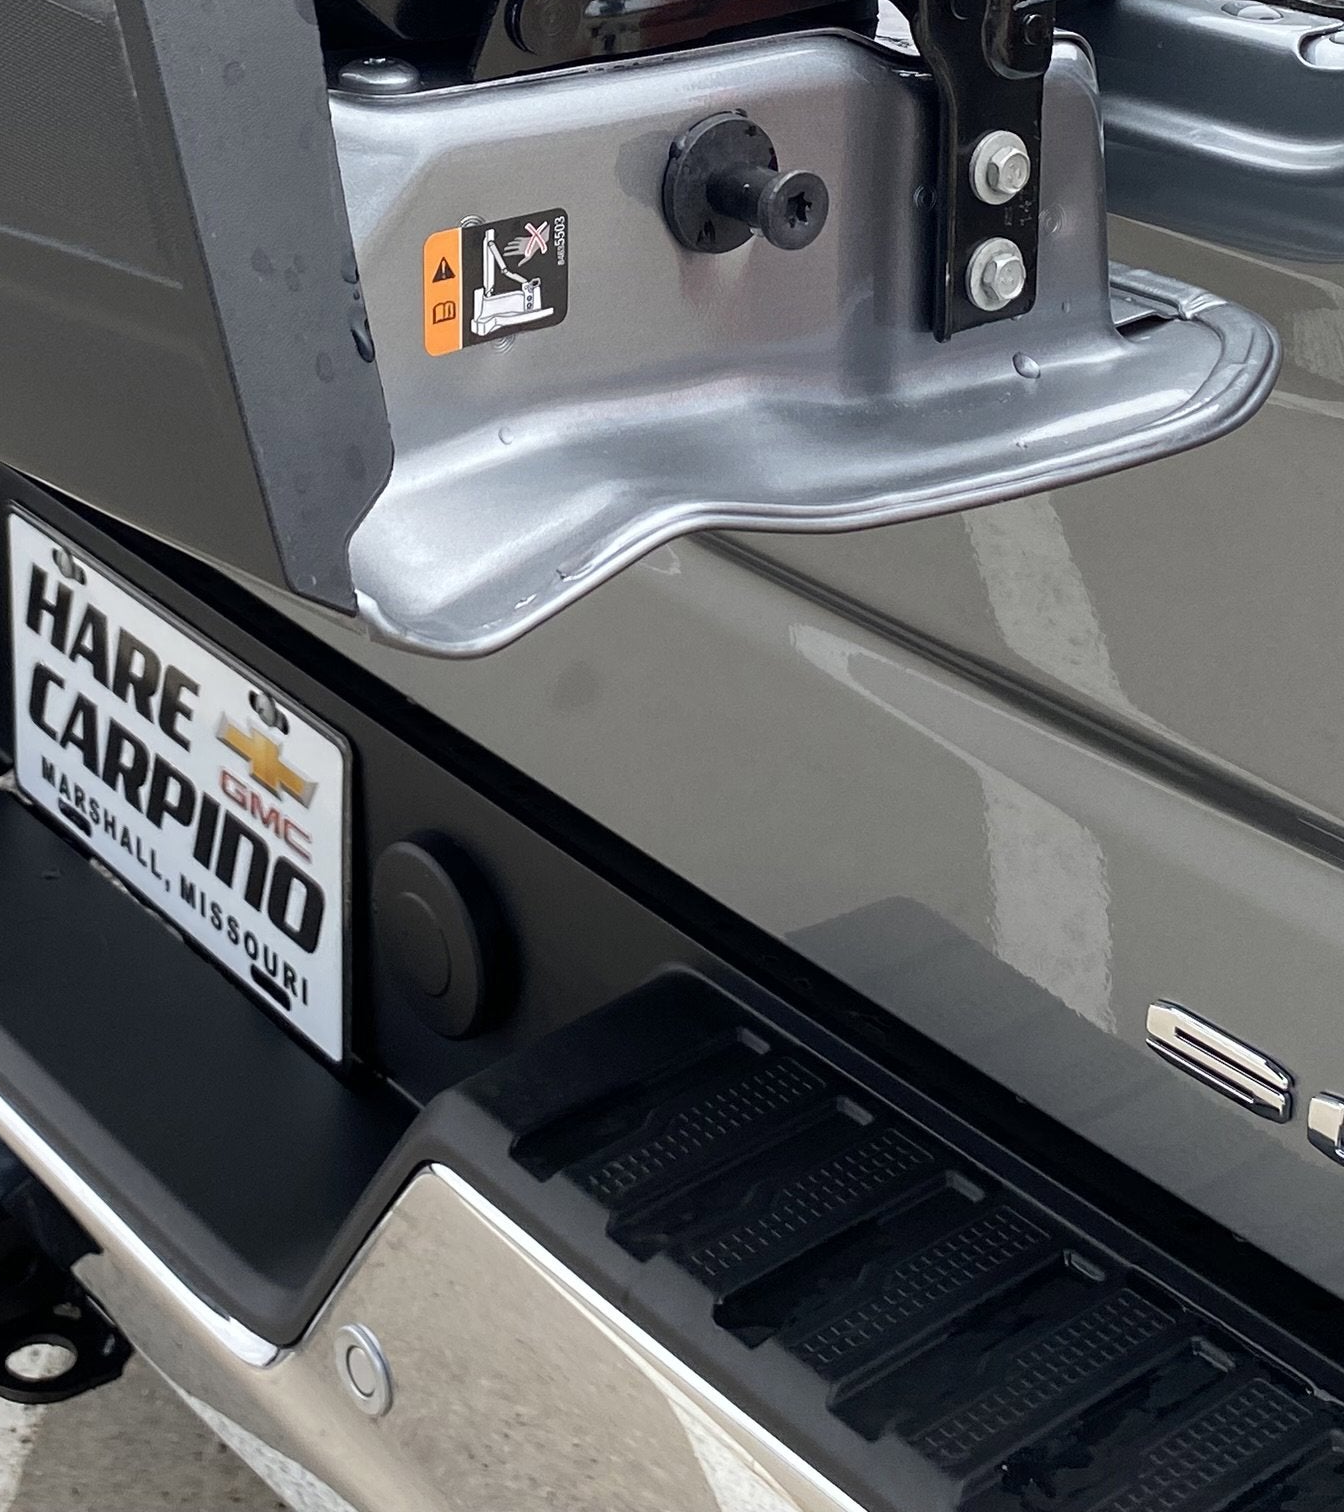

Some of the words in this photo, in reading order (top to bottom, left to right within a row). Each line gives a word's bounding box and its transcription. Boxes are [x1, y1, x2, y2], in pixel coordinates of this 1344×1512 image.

[26, 562, 200, 751] HARE
[28, 662, 326, 954] CARPINO
[41, 755, 172, 892] MARSHALL,
[179, 880, 310, 1006] MISSOURI
[220, 766, 313, 859] GMC
